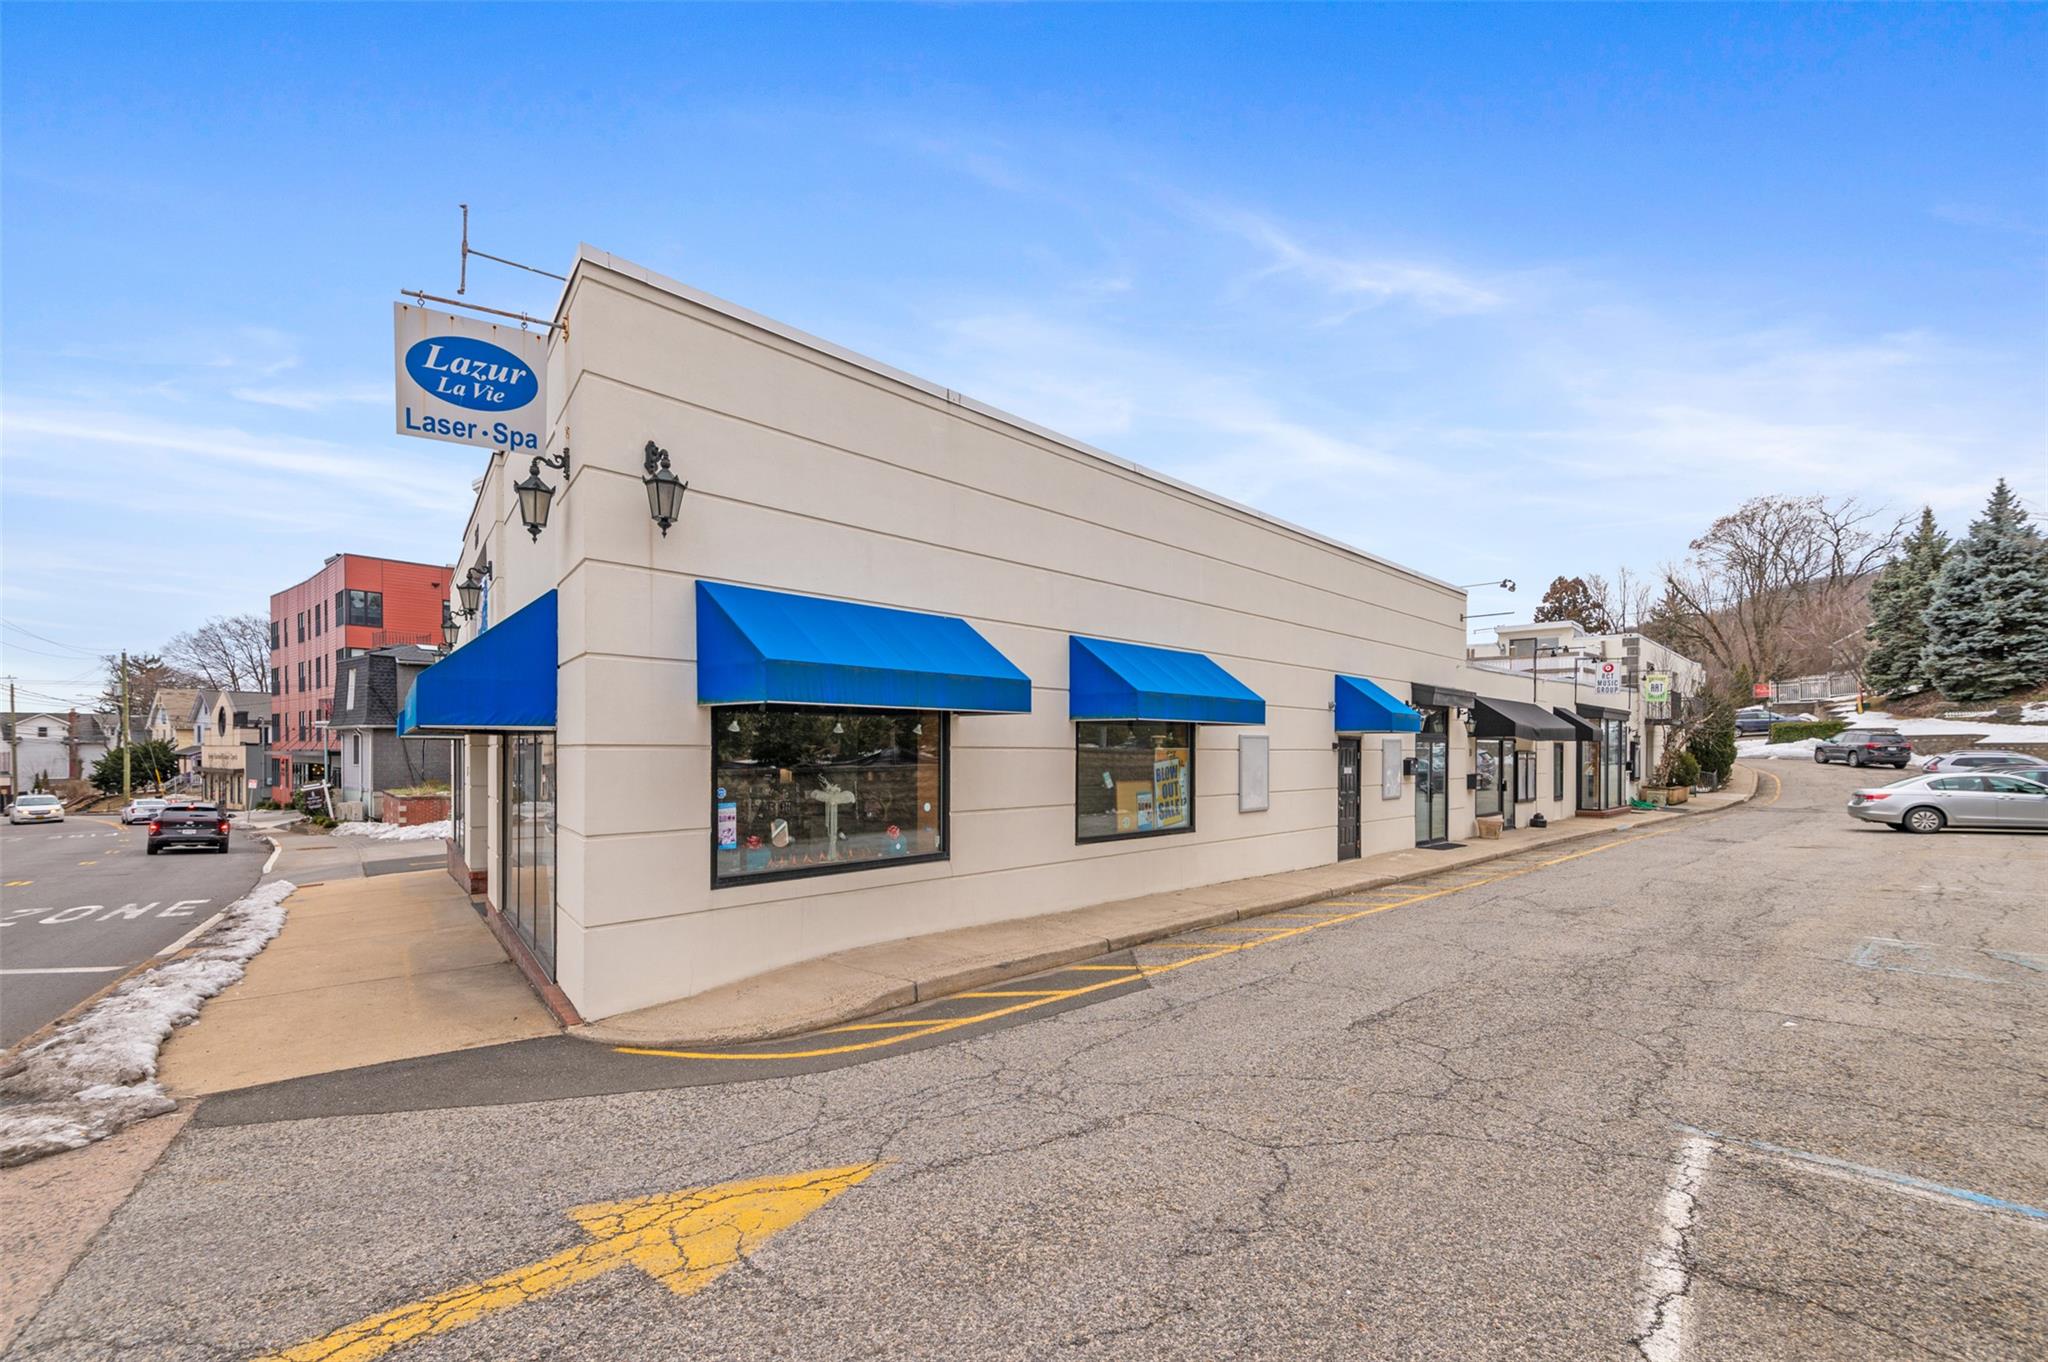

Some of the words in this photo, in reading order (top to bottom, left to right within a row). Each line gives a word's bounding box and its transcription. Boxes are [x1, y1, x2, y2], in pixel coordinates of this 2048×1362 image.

[421, 343, 527, 385] Lazur
[436, 376, 466, 397] La
[473, 382, 505, 403] Vie
[405, 406, 477, 439] Laser
[493, 422, 538, 451] Spa
[1596, 686, 1619, 695] GROUP
[1597, 679, 1619, 687] MUSIC
[1155, 764, 1178, 783] BLOW
[1161, 781, 1179, 800] OUT
[1158, 799, 1181, 821] SALE
[0, 898, 212, 928] ZONE
